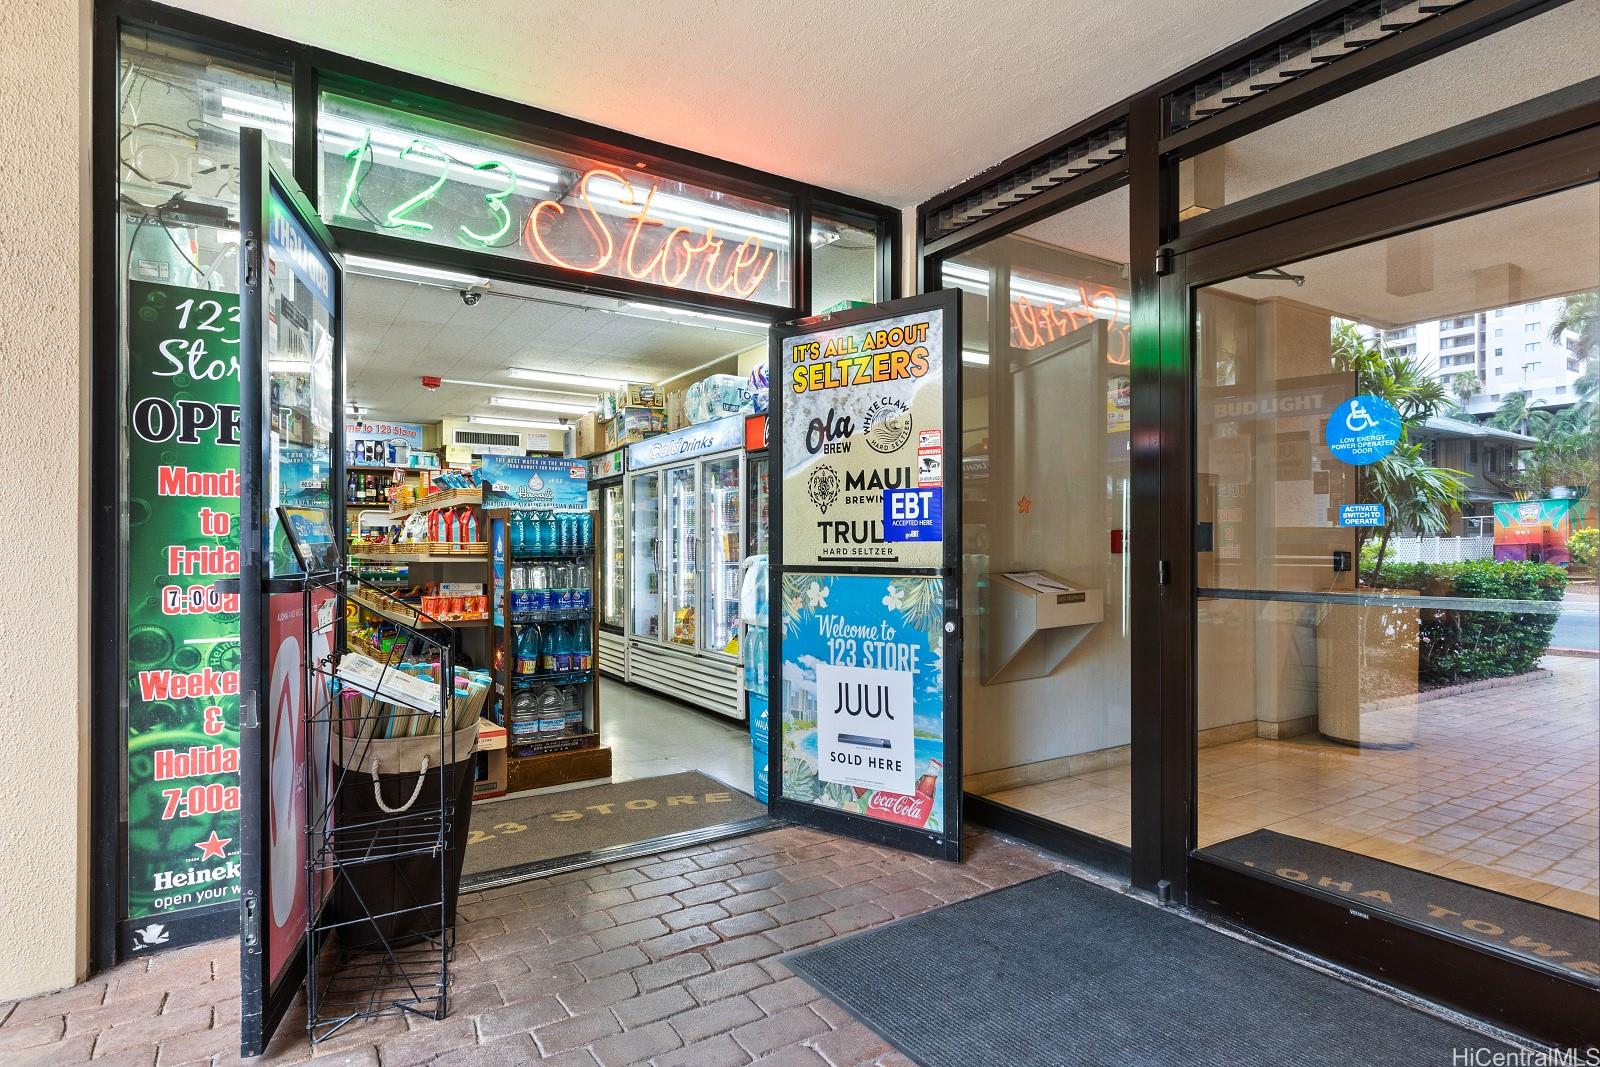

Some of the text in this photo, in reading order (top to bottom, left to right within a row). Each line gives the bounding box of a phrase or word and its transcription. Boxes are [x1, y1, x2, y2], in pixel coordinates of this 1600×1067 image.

[339, 128, 774, 297] 123 Store
[793, 322, 929, 363] IT'S ALL ABOUT
[792, 347, 929, 394] SELTZERS
[863, 396, 910, 435] WHITE CLAW
[376, 424, 392, 435] 123
[394, 426, 417, 438] Store
[679, 436, 714, 454] Drinks
[805, 407, 854, 455] Ola
[871, 440, 889, 451] HARD
[891, 420, 910, 450] SELTZER
[1357, 440, 1396, 448] OPERATED
[824, 441, 851, 454] BREW
[1352, 447, 1373, 455] DOOR
[845, 466, 911, 491] MAUI
[892, 491, 933, 520] EBT
[1342, 511, 1381, 519] SWITCH TO
[200, 507, 230, 537] to
[818, 520, 892, 544] TRUL
[893, 519, 918, 527] ACCEPTED
[823, 547, 893, 556] HARD SELTZER
[815, 614, 896, 641] Welcome to
[827, 638, 921, 674] 123 STORE
[834, 682, 895, 721] JUUL
[203, 706, 225, 736] &
[830, 751, 902, 772] SOLD HERE
[551, 791, 733, 823] STORE
[1245, 861, 1393, 905] OHA
[154, 892, 191, 910] open
[196, 886, 228, 904] your
